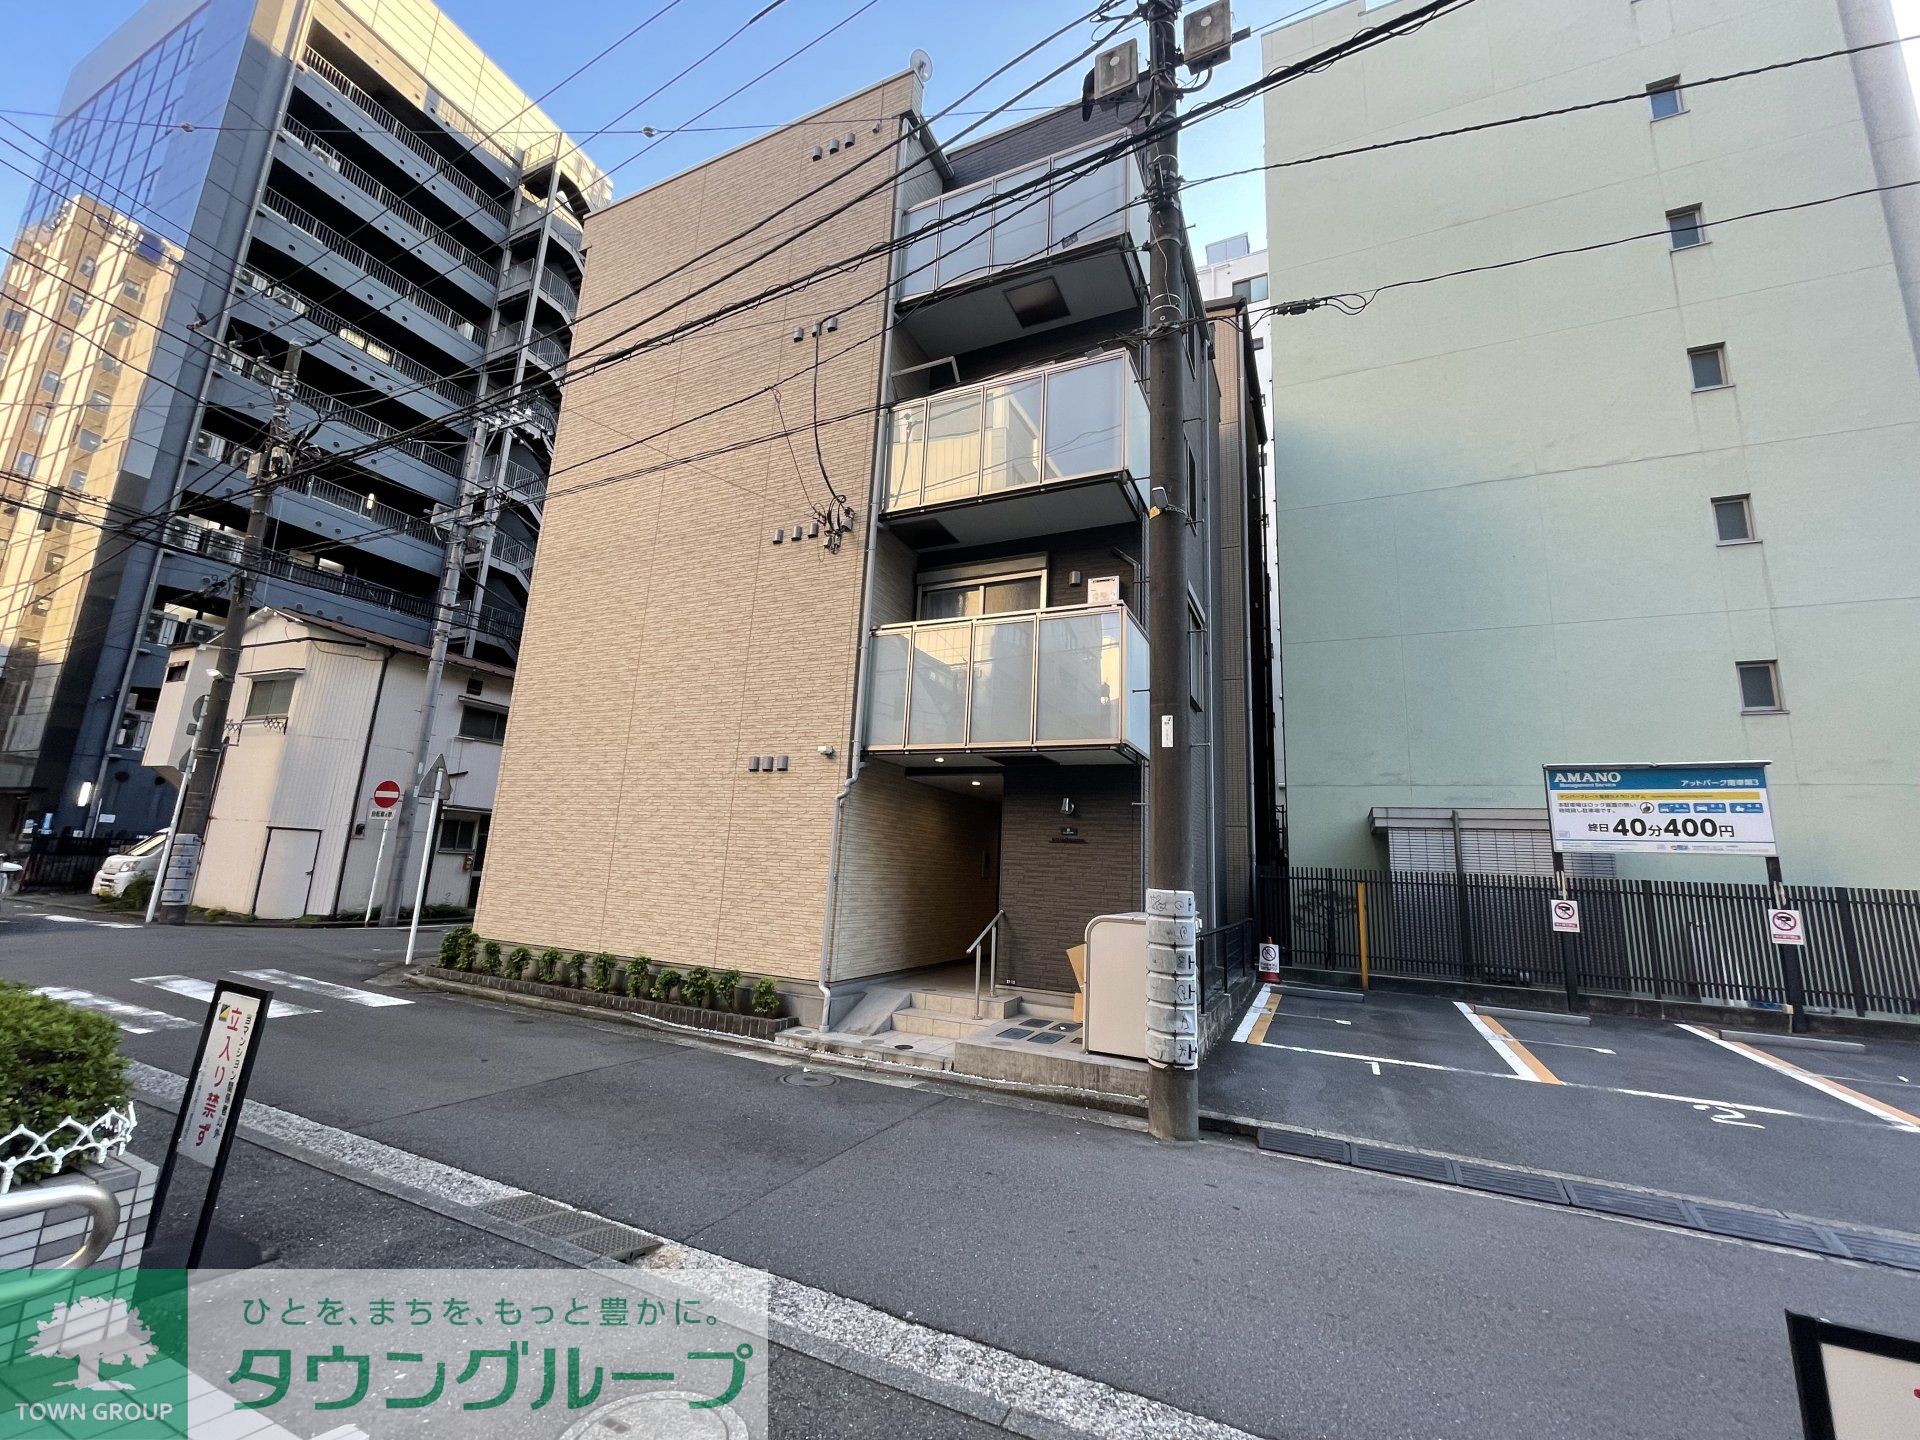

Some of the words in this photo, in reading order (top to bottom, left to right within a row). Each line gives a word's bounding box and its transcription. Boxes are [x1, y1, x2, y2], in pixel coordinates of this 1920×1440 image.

[1554, 772, 1622, 783] AMANO
[1588, 823, 1609, 833] 終日
[1612, 818, 1735, 838] 40分400円
[195, 1008, 243, 1147] 立入り禁ず
